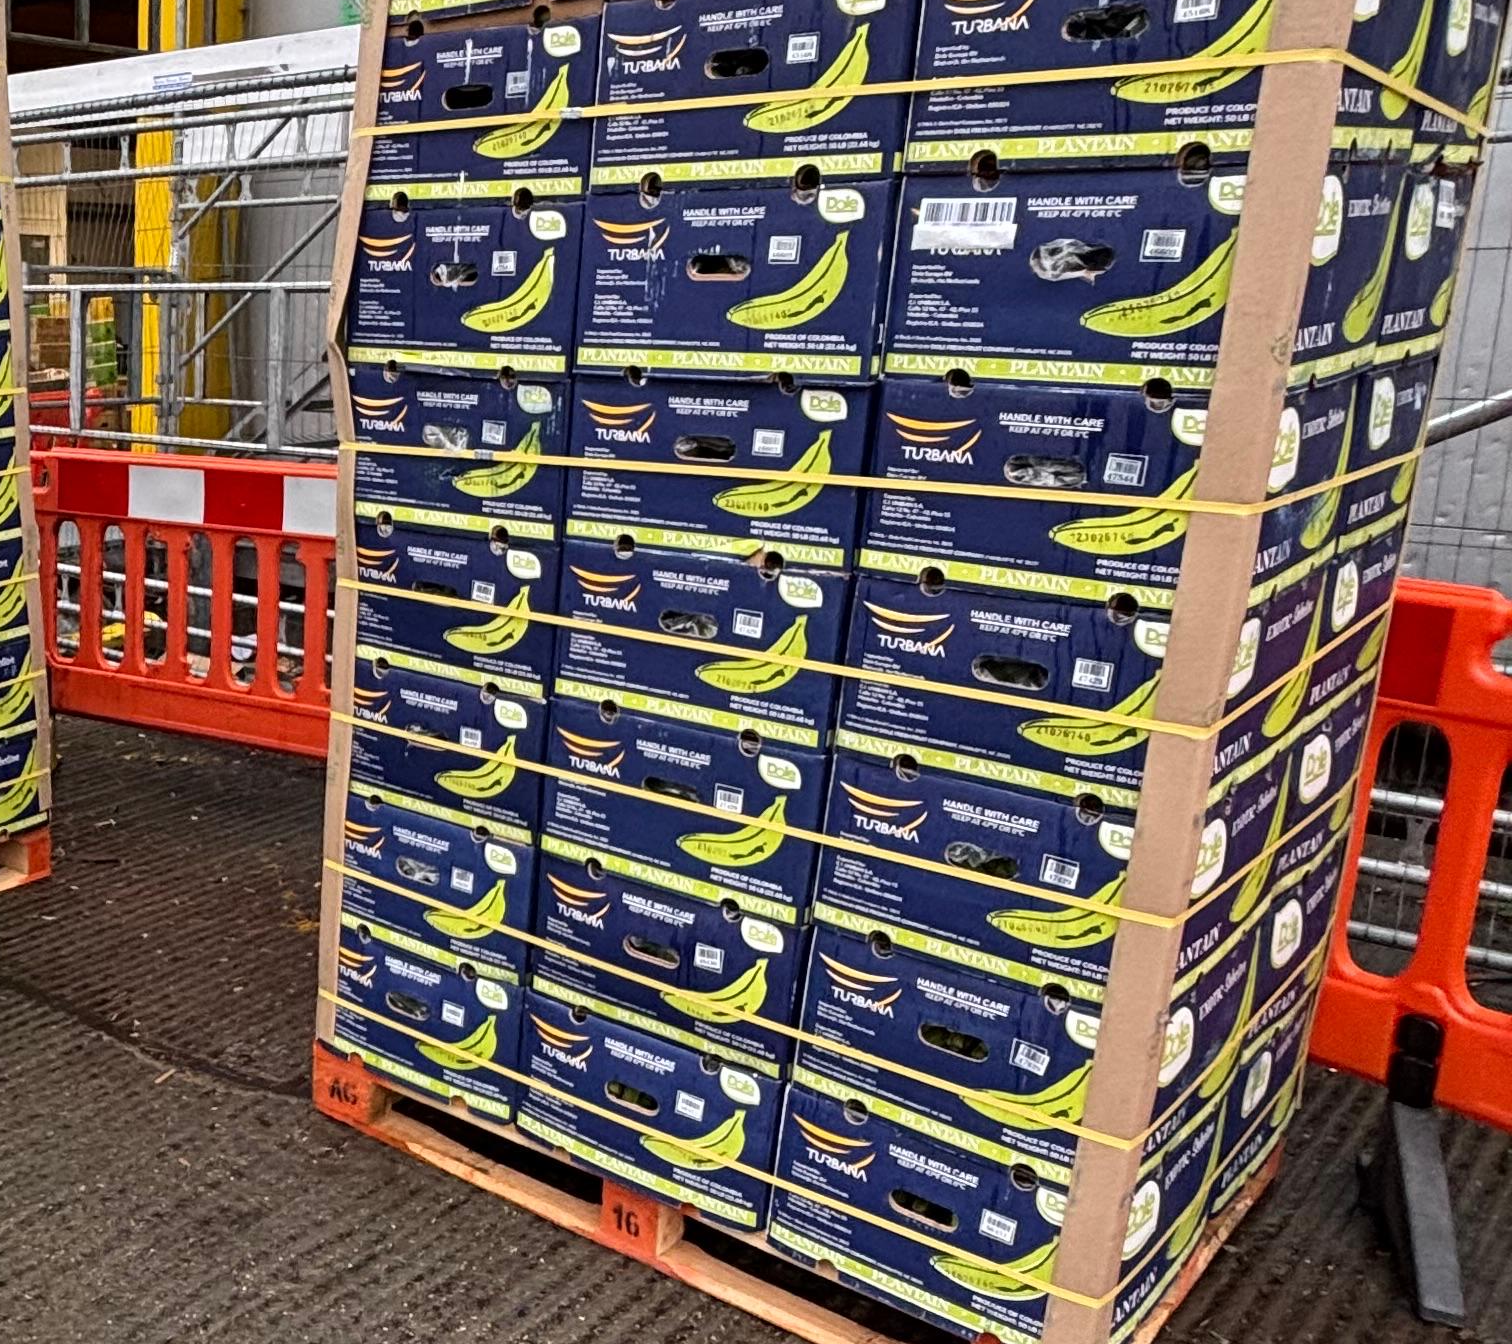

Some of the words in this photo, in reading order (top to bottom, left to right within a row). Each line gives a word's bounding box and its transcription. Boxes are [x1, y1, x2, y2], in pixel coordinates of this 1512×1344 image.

[951, 15, 1029, 35] TURBANA
[1037, 135, 1136, 155] PLANTAIN
[826, 196, 858, 211] Dole
[1027, 195, 1072, 208] HANDLE
[1074, 195, 1102, 206] WITH
[1105, 195, 1138, 206] CARE
[683, 208, 717, 217] HANDLE
[719, 207, 741, 216] WITH
[743, 206, 766, 215] CARE
[608, 248, 665, 261] TURBANA
[368, 260, 412, 272] TURBANA
[671, 352, 745, 368] PLANTAIN
[1010, 360, 1105, 379] PLANTAIN
[595, 428, 650, 444] TURBANA
[902, 446, 974, 465] TURBANA
[980, 566, 1072, 591] PLANTAIN
[877, 634, 946, 657] TURBANA
[854, 814, 919, 844] TURBANA
[805, 1146, 867, 1182] TURBANA
[889, 1143, 927, 1163] HANDLE
[928, 1156, 951, 1172] WITH
[953, 1165, 979, 1184] CARE
[612, 1205, 640, 1239] 16
